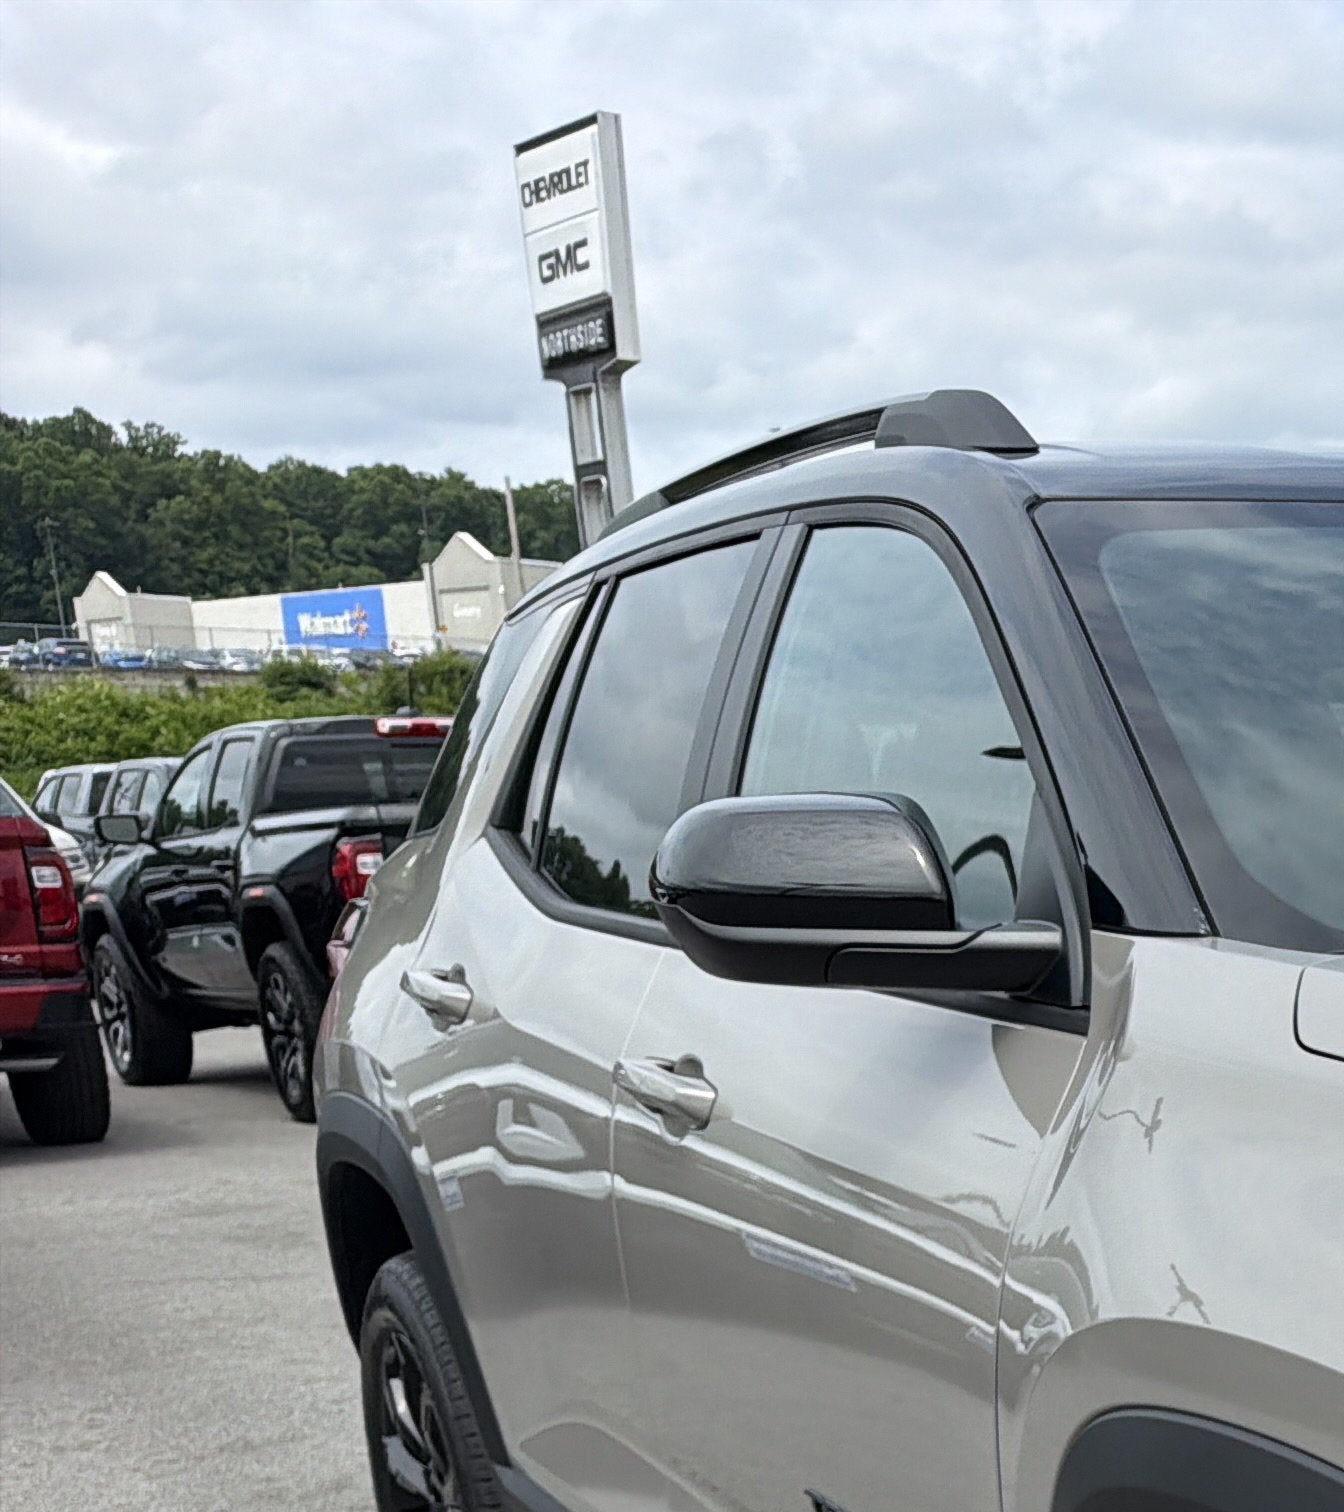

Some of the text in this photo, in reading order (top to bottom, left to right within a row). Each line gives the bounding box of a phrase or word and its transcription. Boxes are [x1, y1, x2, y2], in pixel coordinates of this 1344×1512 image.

[520, 158, 590, 209] CHEVROLET
[537, 236, 591, 285] GMC
[296, 608, 354, 639] Walmart
